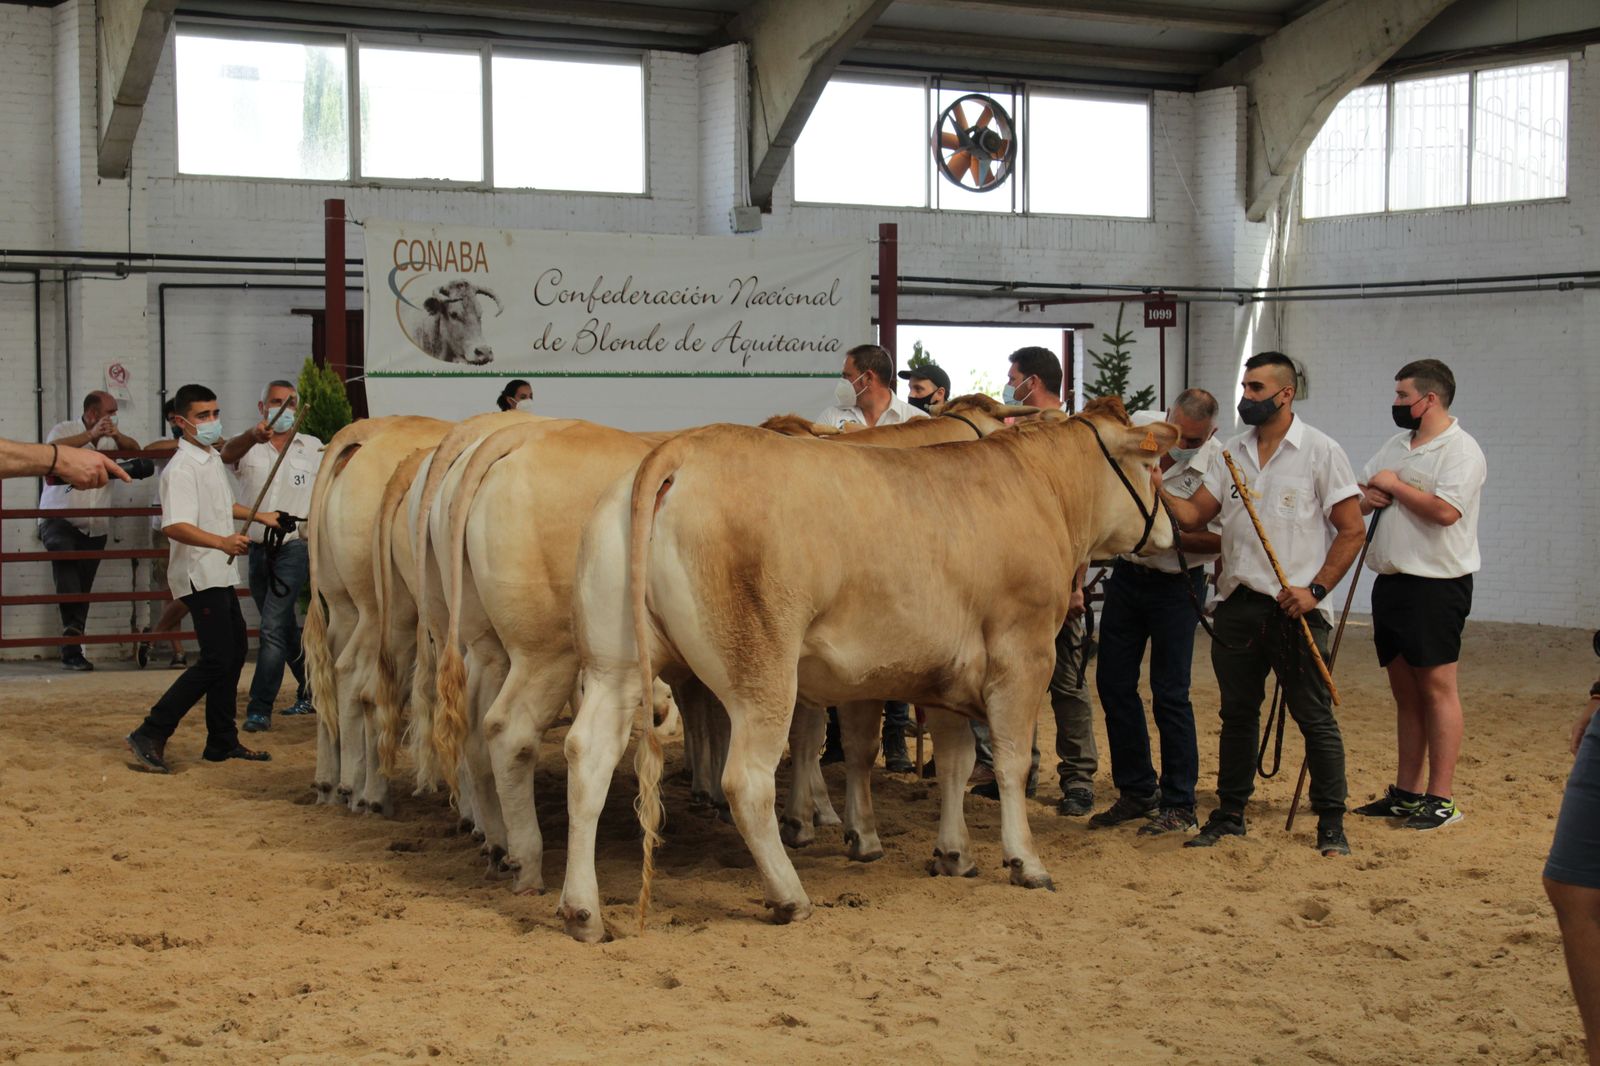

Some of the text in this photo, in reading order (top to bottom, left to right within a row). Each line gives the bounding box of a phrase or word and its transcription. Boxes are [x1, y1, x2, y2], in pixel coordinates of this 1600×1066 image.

[393, 239, 489, 273] CONABA
[534, 268, 843, 313] Confederación Nacional
[1148, 309, 1173, 320] 1099
[533, 318, 843, 367] de Blonde de Aquitania
[294, 474, 305, 486] 31
